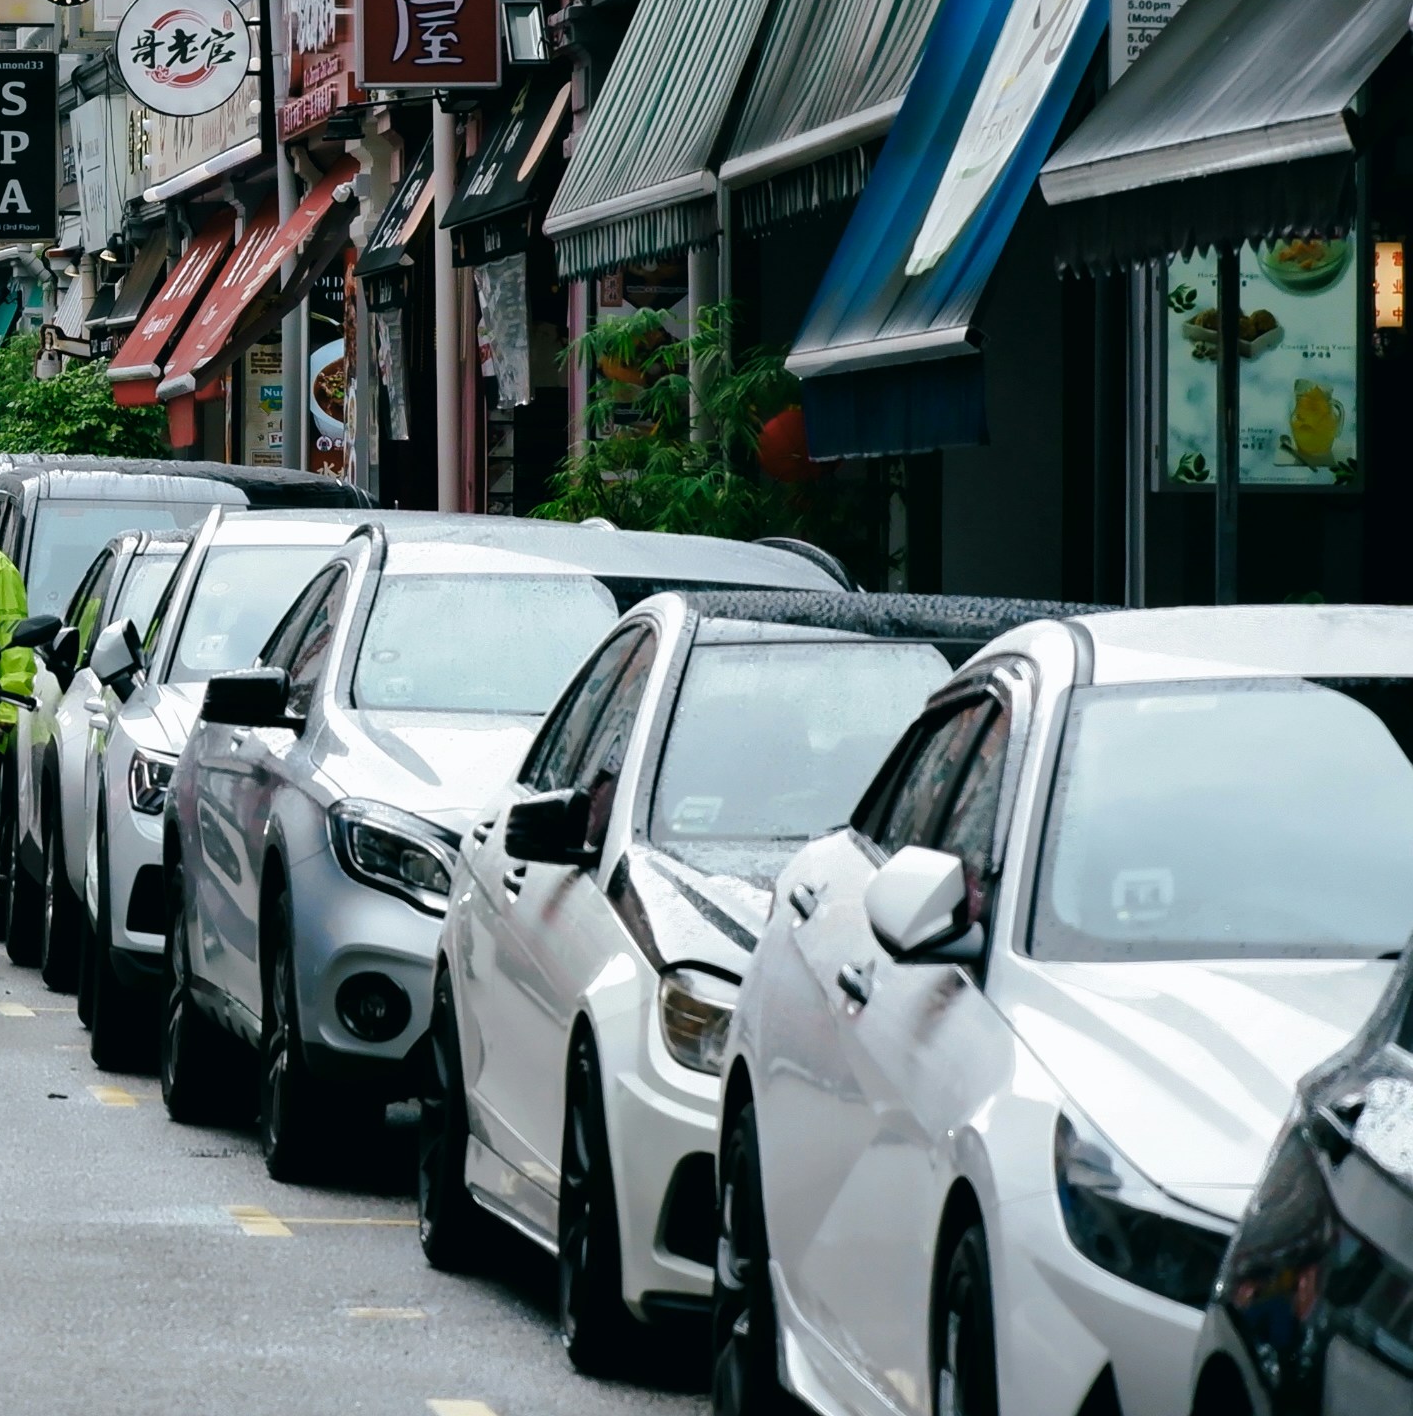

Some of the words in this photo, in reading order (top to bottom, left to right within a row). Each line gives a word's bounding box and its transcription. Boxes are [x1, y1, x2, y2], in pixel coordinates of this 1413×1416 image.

[1128, 0, 1171, 11] 5.00pm
[130, 28, 237, 69] 哥老官
[3, 223, 17, 232] (3rd
[18, 223, 40, 232] Floor)
